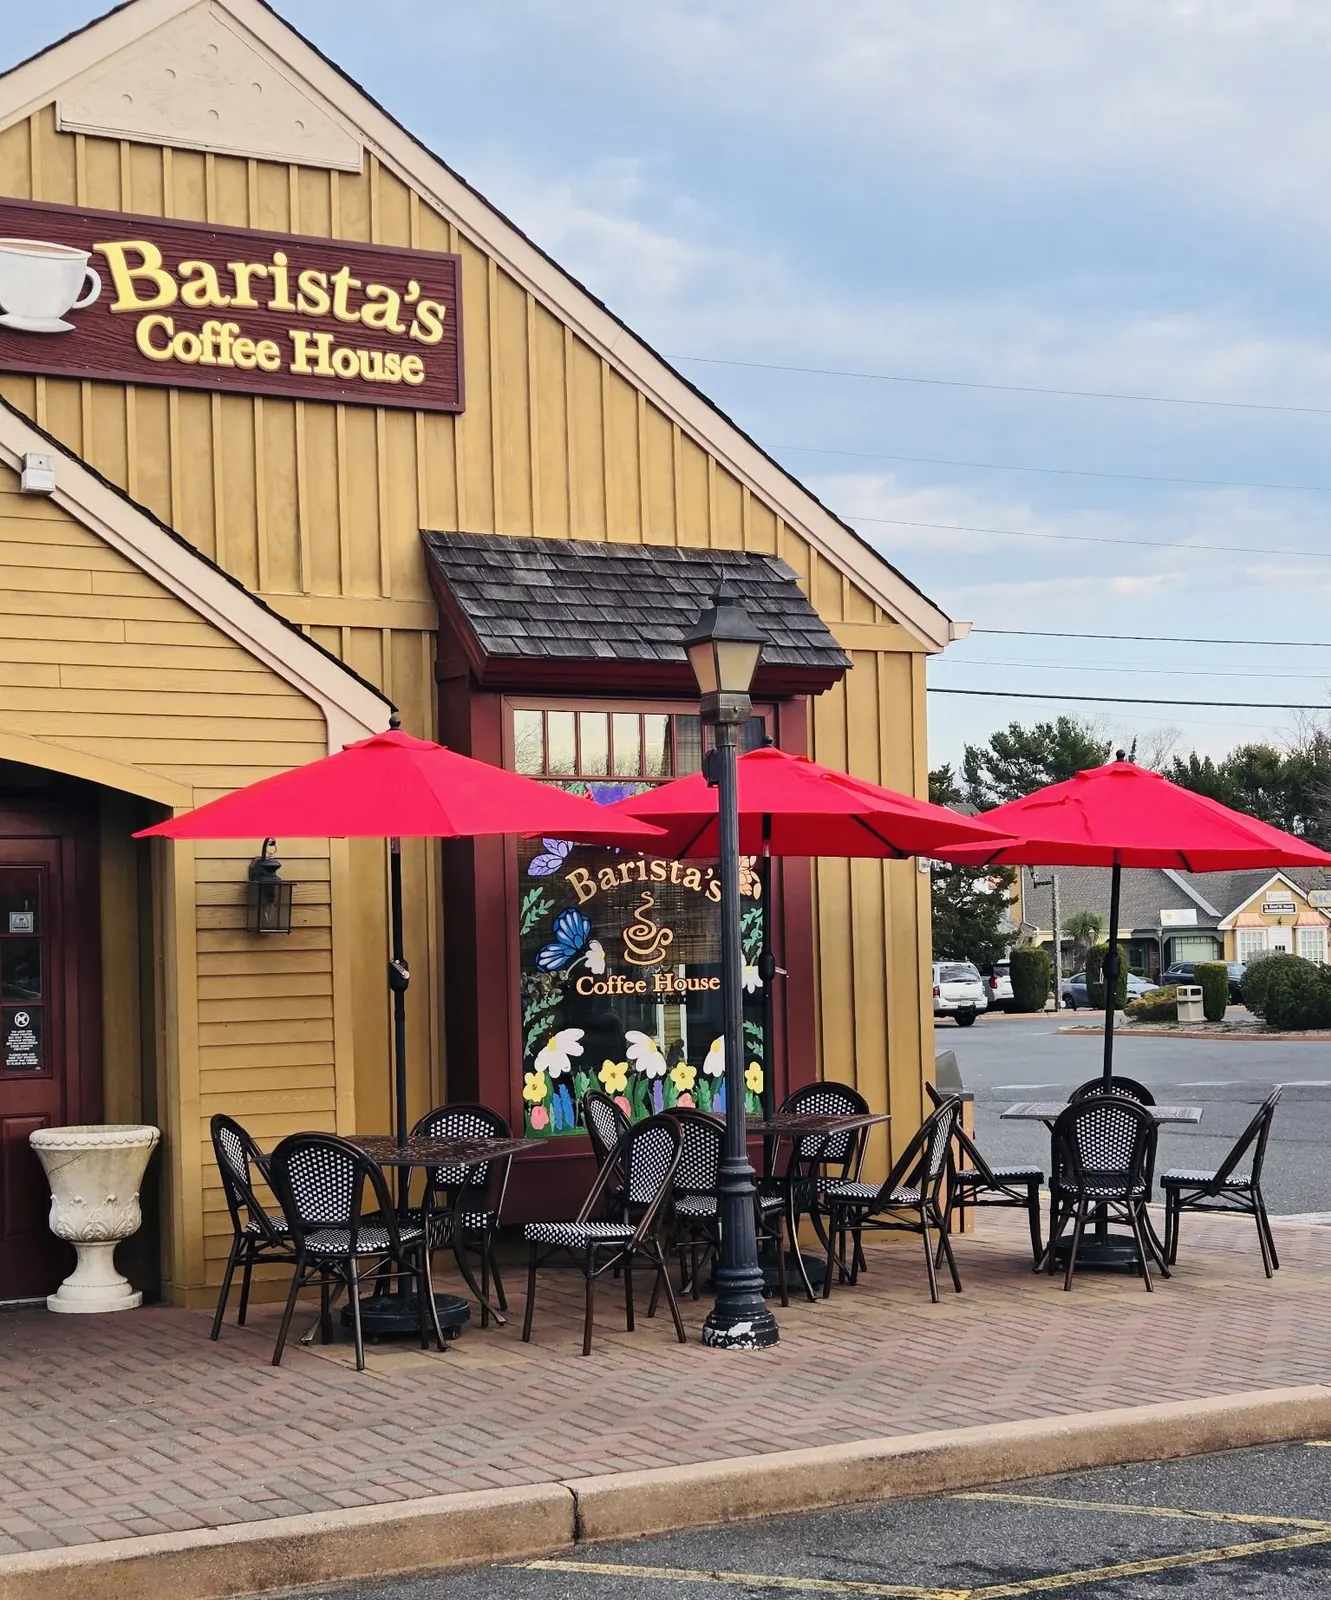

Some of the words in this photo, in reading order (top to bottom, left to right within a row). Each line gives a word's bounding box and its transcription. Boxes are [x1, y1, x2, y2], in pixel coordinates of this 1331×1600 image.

[92, 240, 447, 345] Barista's
[136, 314, 281, 372] Coffee
[288, 329, 426, 386] House
[565, 860, 721, 905] Barista's
[576, 975, 647, 996] Coffee
[653, 973, 721, 992] House
